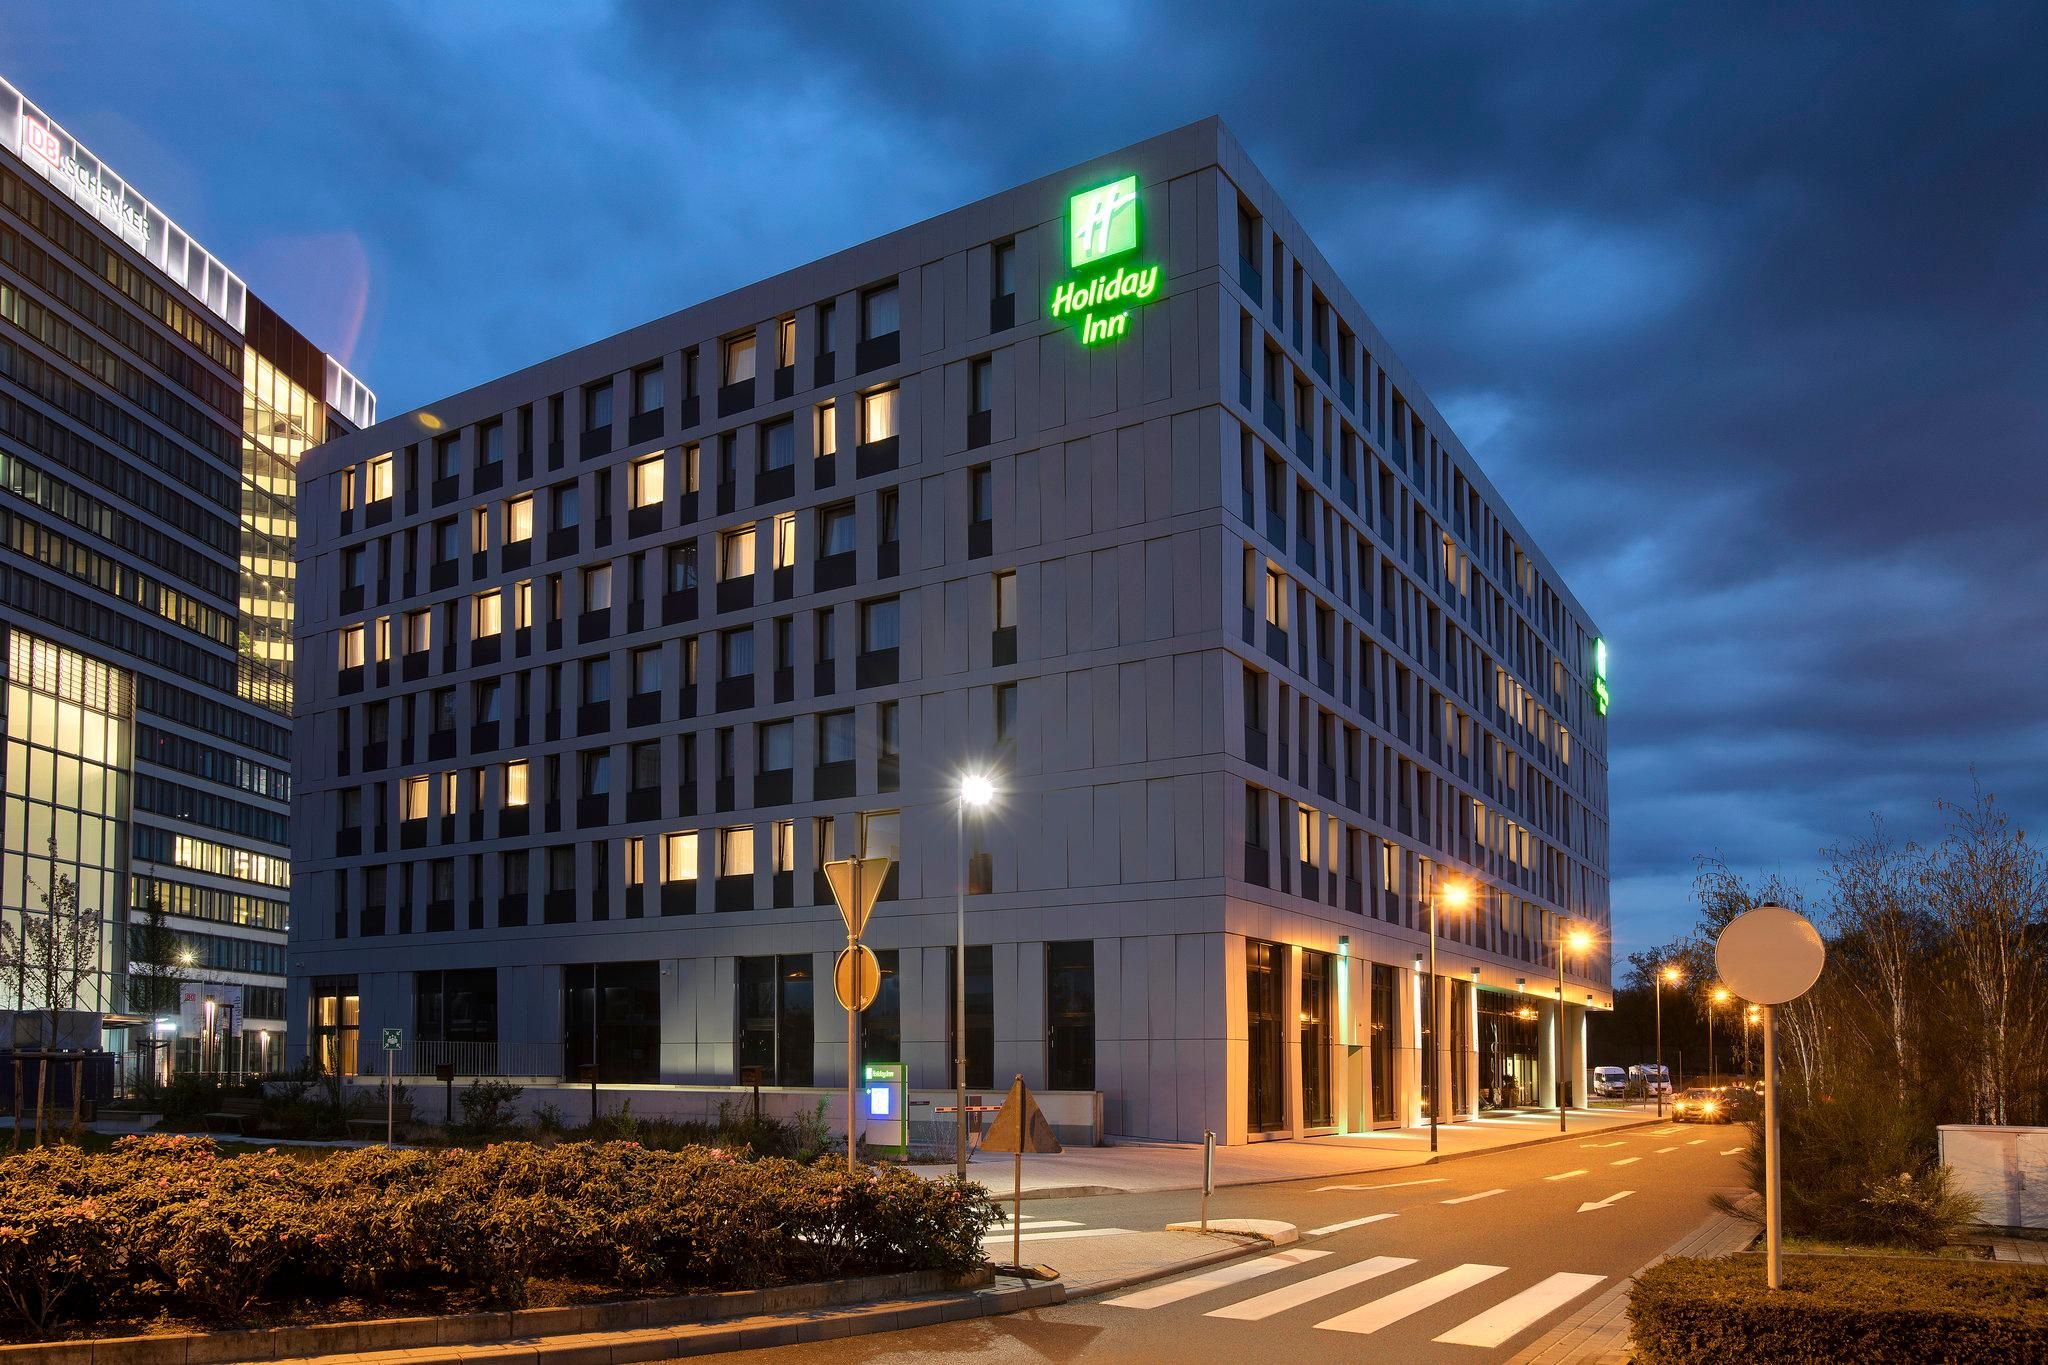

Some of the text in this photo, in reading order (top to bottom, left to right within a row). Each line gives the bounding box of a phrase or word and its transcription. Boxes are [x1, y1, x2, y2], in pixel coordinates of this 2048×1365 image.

[32, 125, 150, 241] DB SCHENKER
[1051, 266, 1158, 317] Holiday
[1082, 312, 1127, 345] Inn
